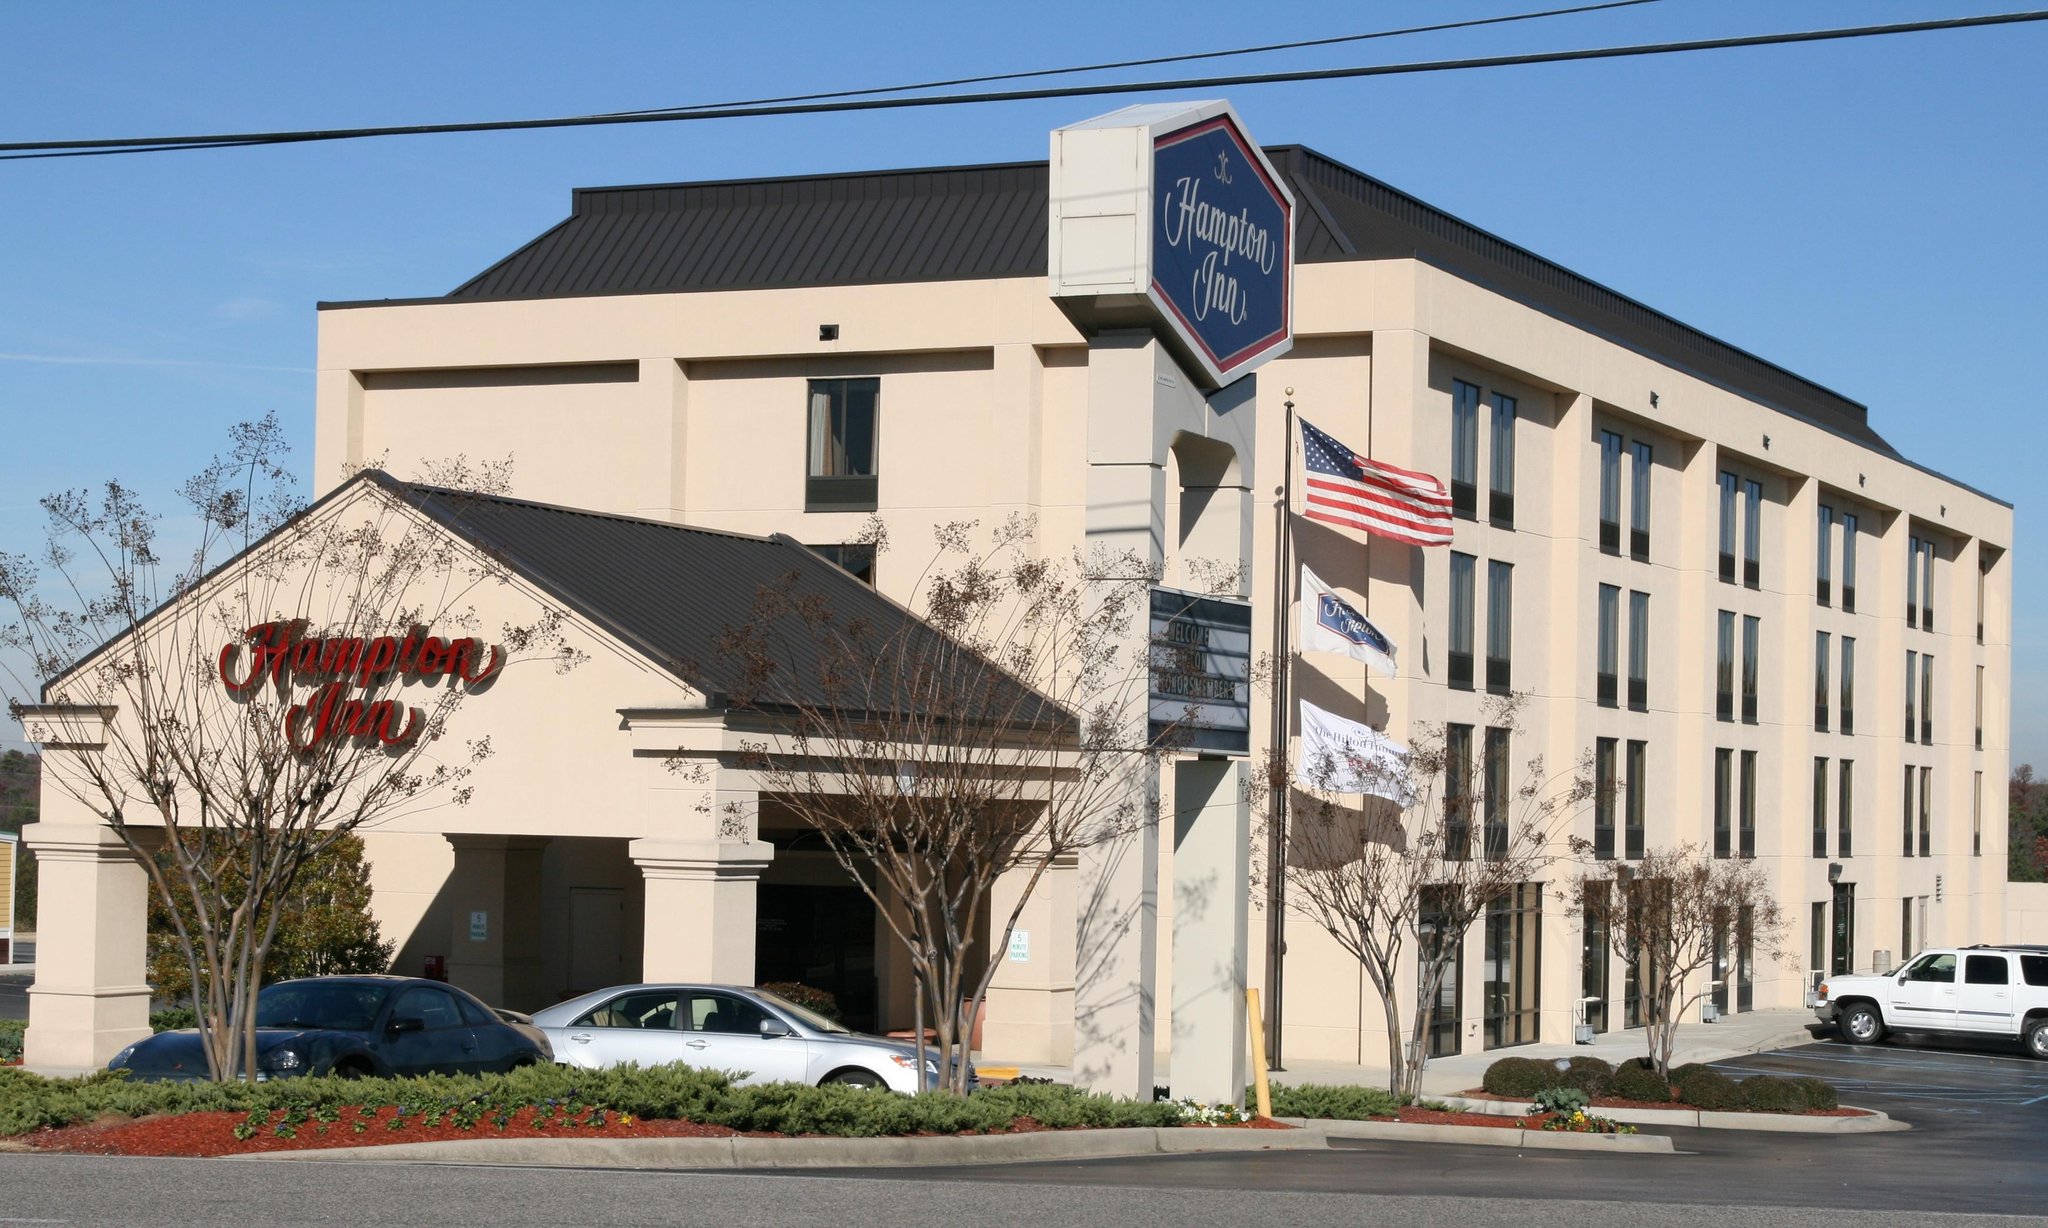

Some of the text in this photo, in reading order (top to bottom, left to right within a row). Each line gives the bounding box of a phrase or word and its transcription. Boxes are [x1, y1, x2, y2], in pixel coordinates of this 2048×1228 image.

[1165, 176, 1275, 275] Hampton
[1193, 250, 1246, 326] Inn
[219, 618, 502, 694] Hampton
[285, 681, 421, 754] Inn
[1017, 933, 1022, 942] 5
